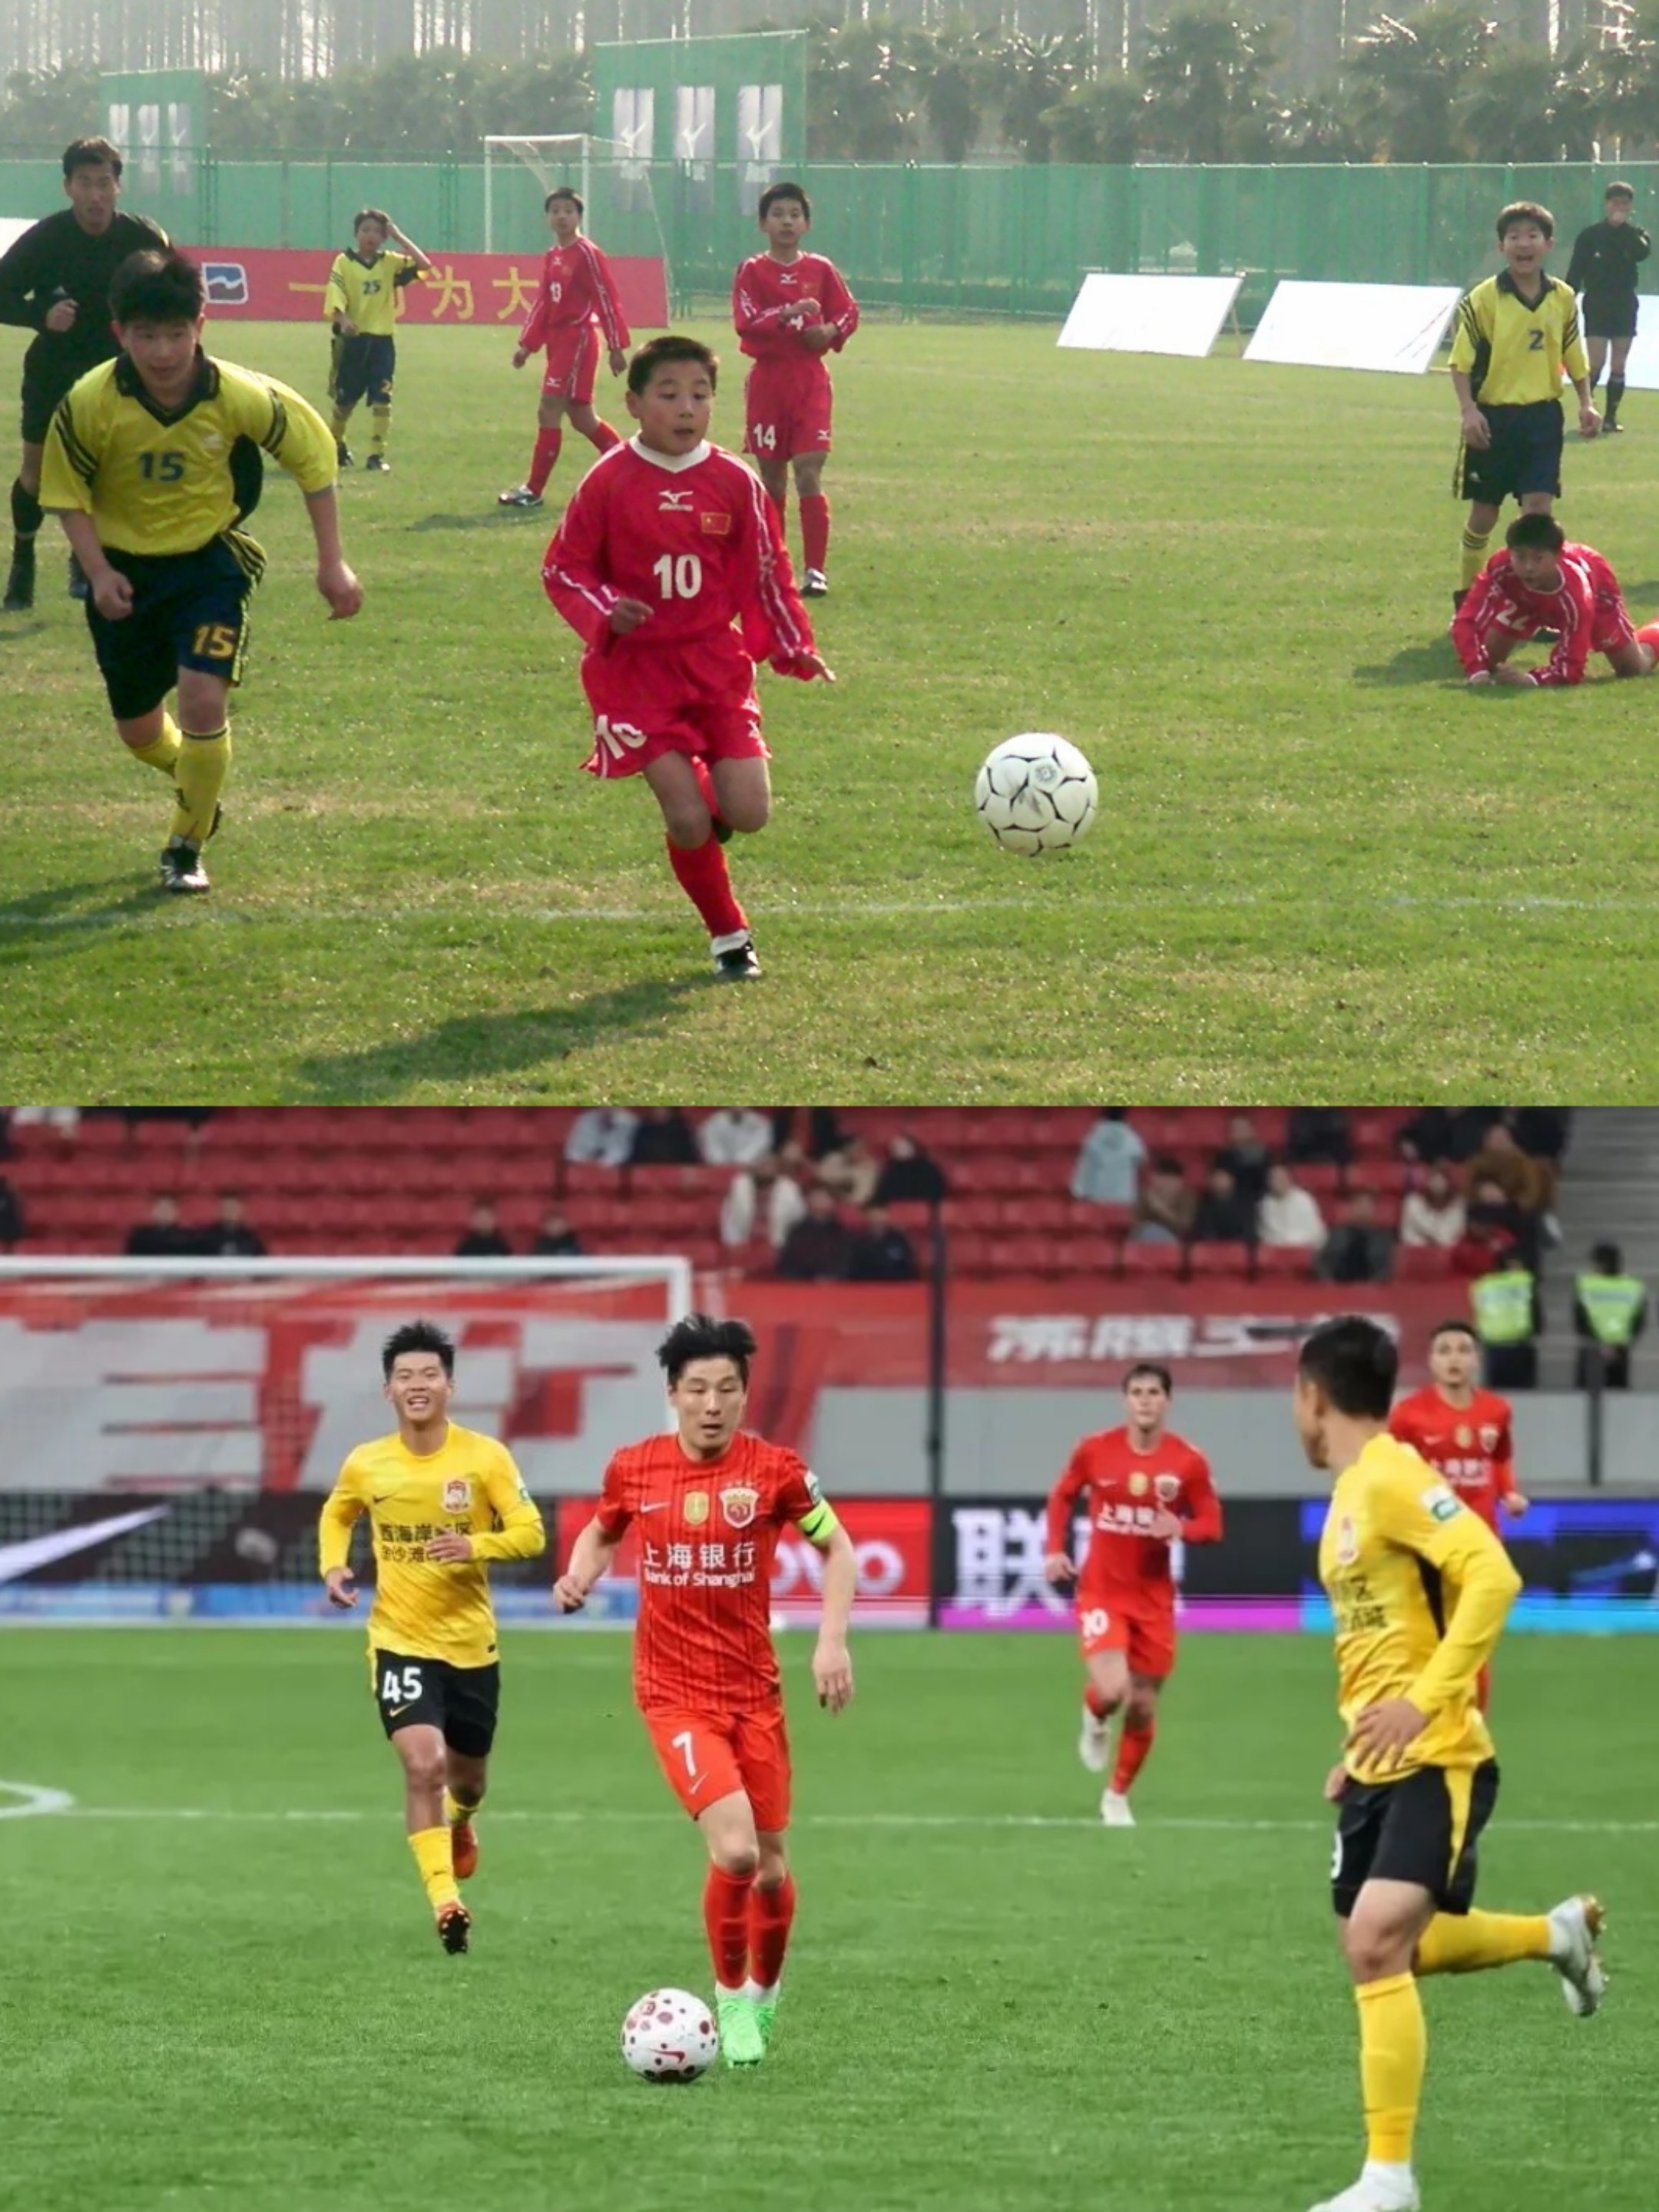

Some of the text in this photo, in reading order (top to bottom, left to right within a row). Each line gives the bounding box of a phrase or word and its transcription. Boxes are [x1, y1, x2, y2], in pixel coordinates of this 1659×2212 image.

[288, 265, 540, 320] 一为大
[1528, 328, 1545, 351] 2
[753, 422, 777, 451] 14
[139, 451, 184, 482] 15
[654, 553, 703, 600] 10
[193, 624, 234, 658] 15
[379, 1522, 472, 1543] 西海岸区
[644, 1541, 756, 1569] 上海银行
[673, 1571, 689, 1586] of
[382, 1666, 423, 1704] 45
[671, 1730, 697, 1777] 7
